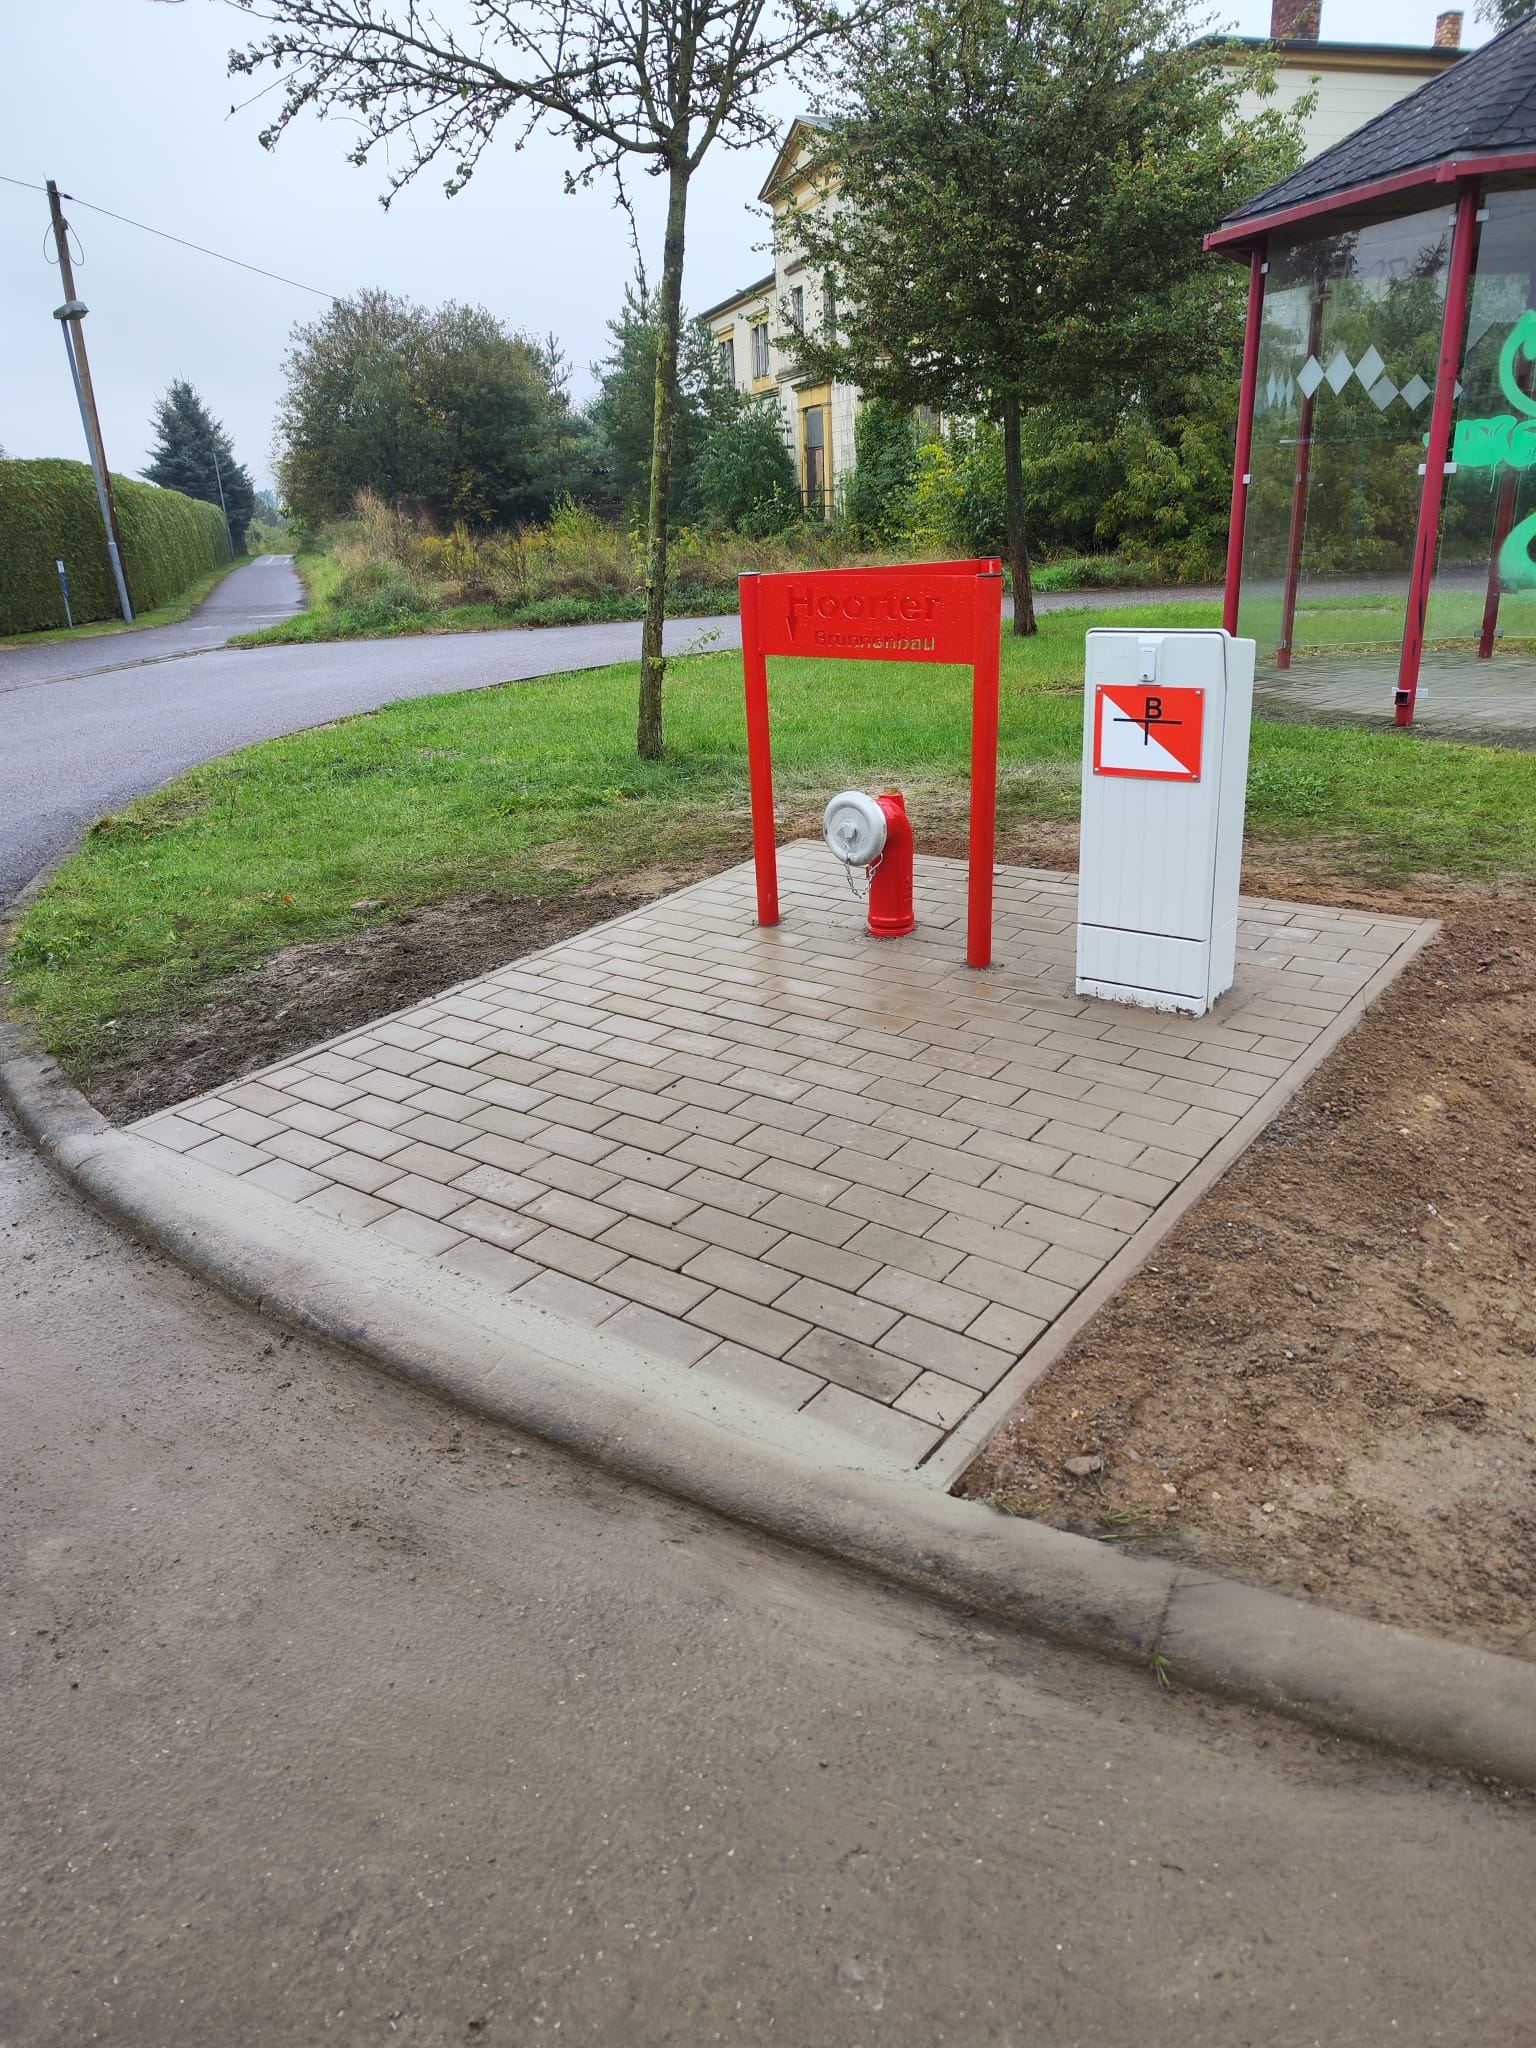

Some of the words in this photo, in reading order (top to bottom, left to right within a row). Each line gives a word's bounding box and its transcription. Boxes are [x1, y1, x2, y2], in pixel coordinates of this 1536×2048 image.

[786, 585, 943, 624] Hoorter
[814, 629, 936, 651] Brunnenbau
[1145, 697, 1162, 719] B
